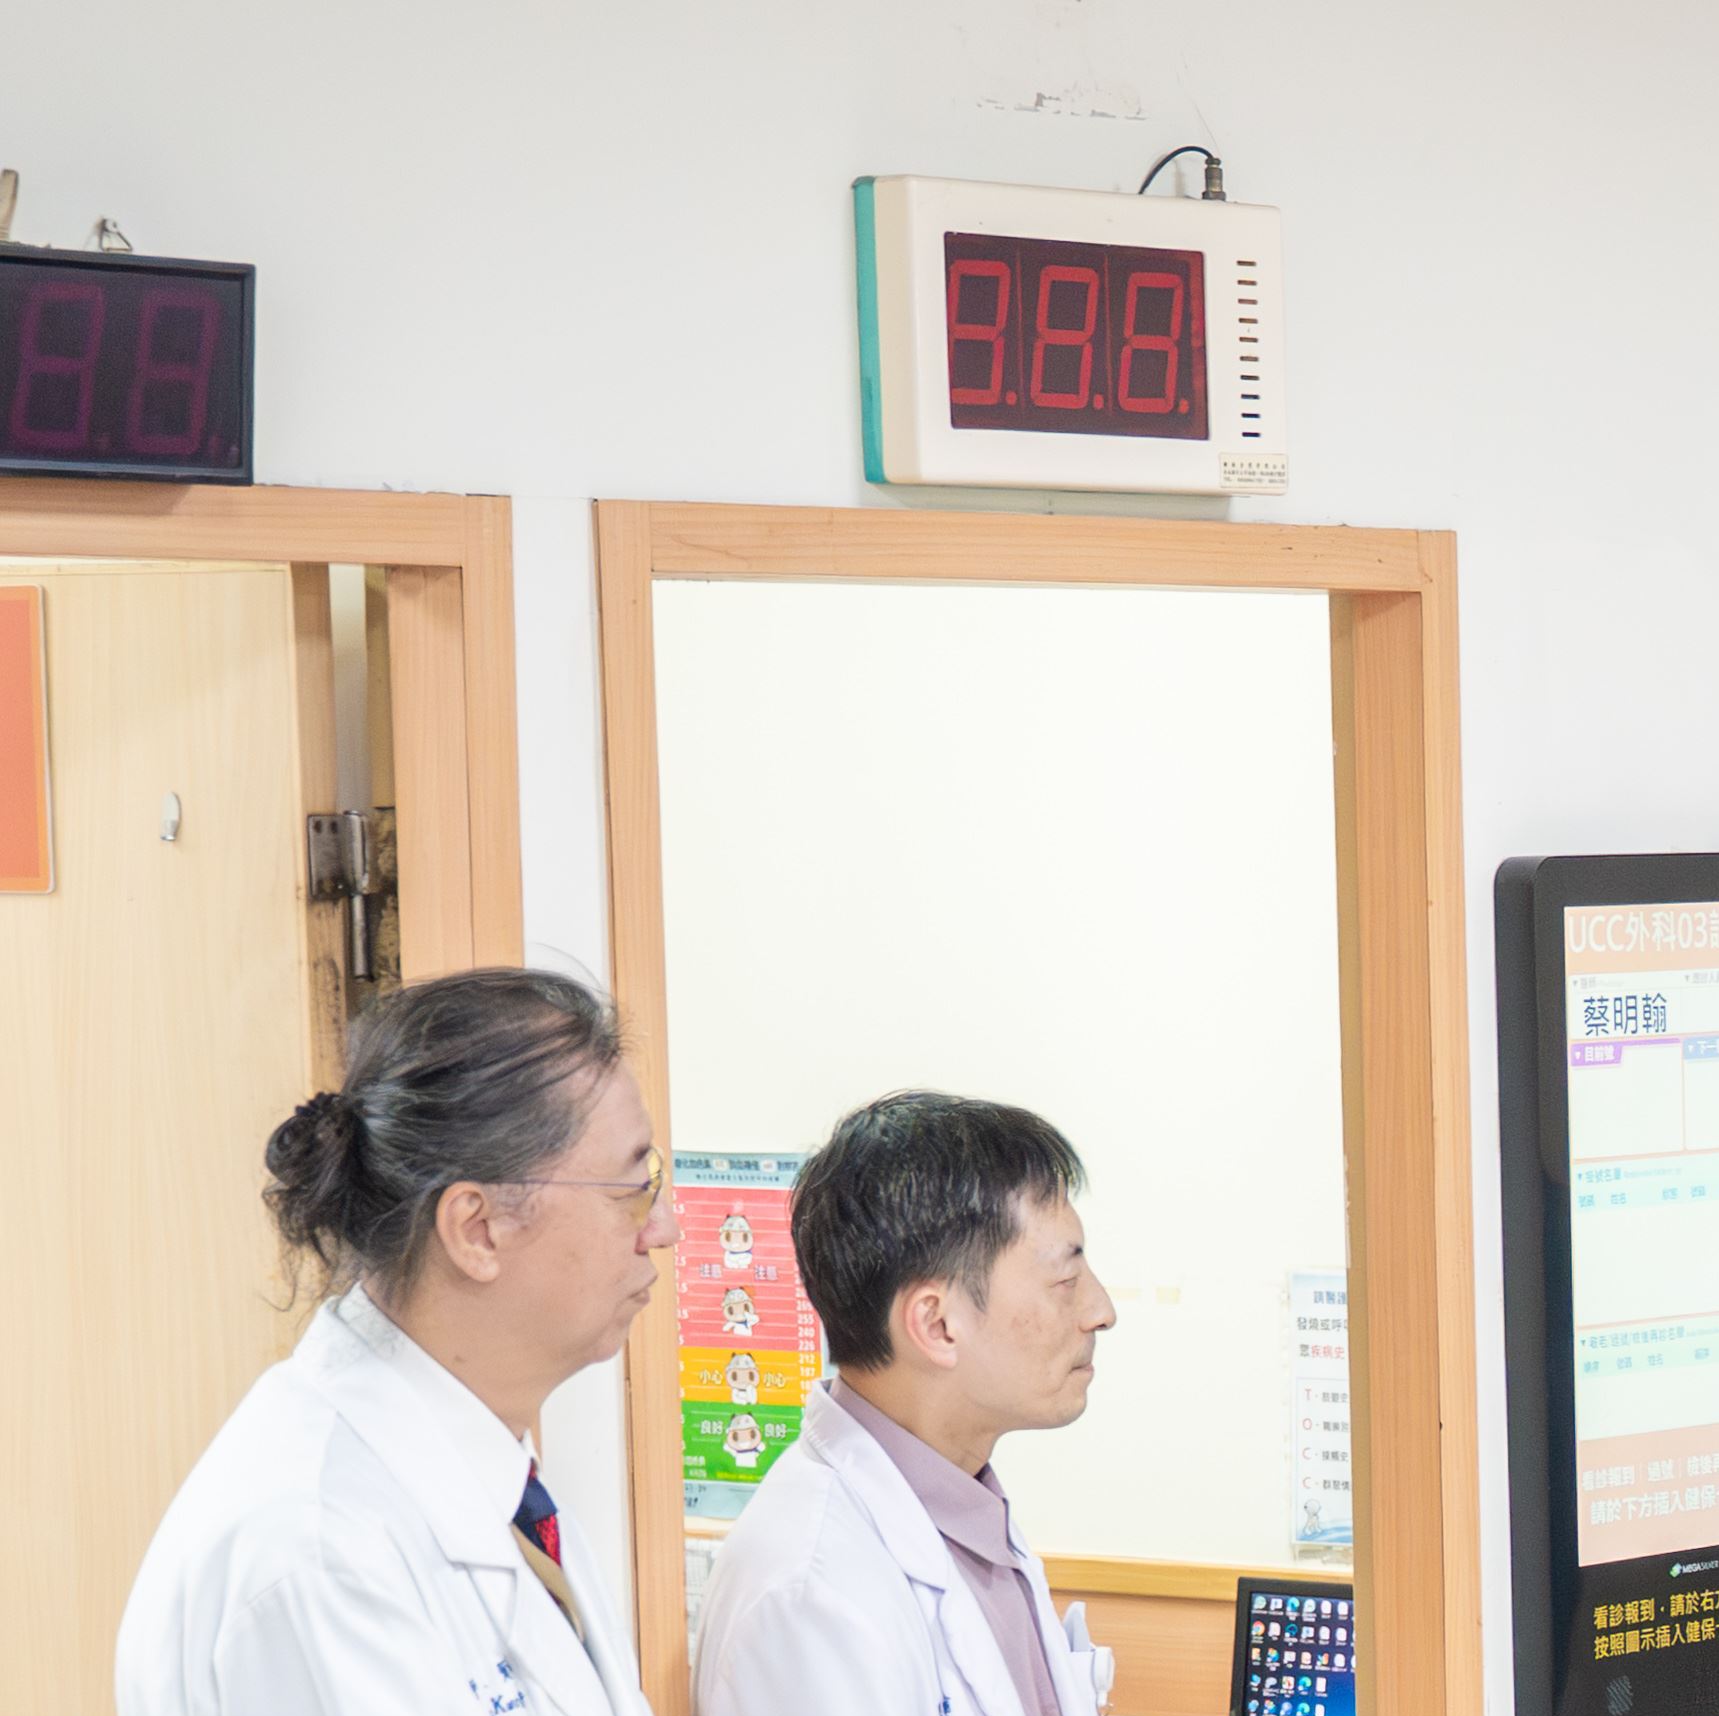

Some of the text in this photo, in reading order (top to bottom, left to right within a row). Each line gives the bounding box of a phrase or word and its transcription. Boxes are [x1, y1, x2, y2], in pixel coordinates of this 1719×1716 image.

[1583, 992, 1668, 1037] 蔡明翰
[699, 1369, 787, 1388] 小心 小心
